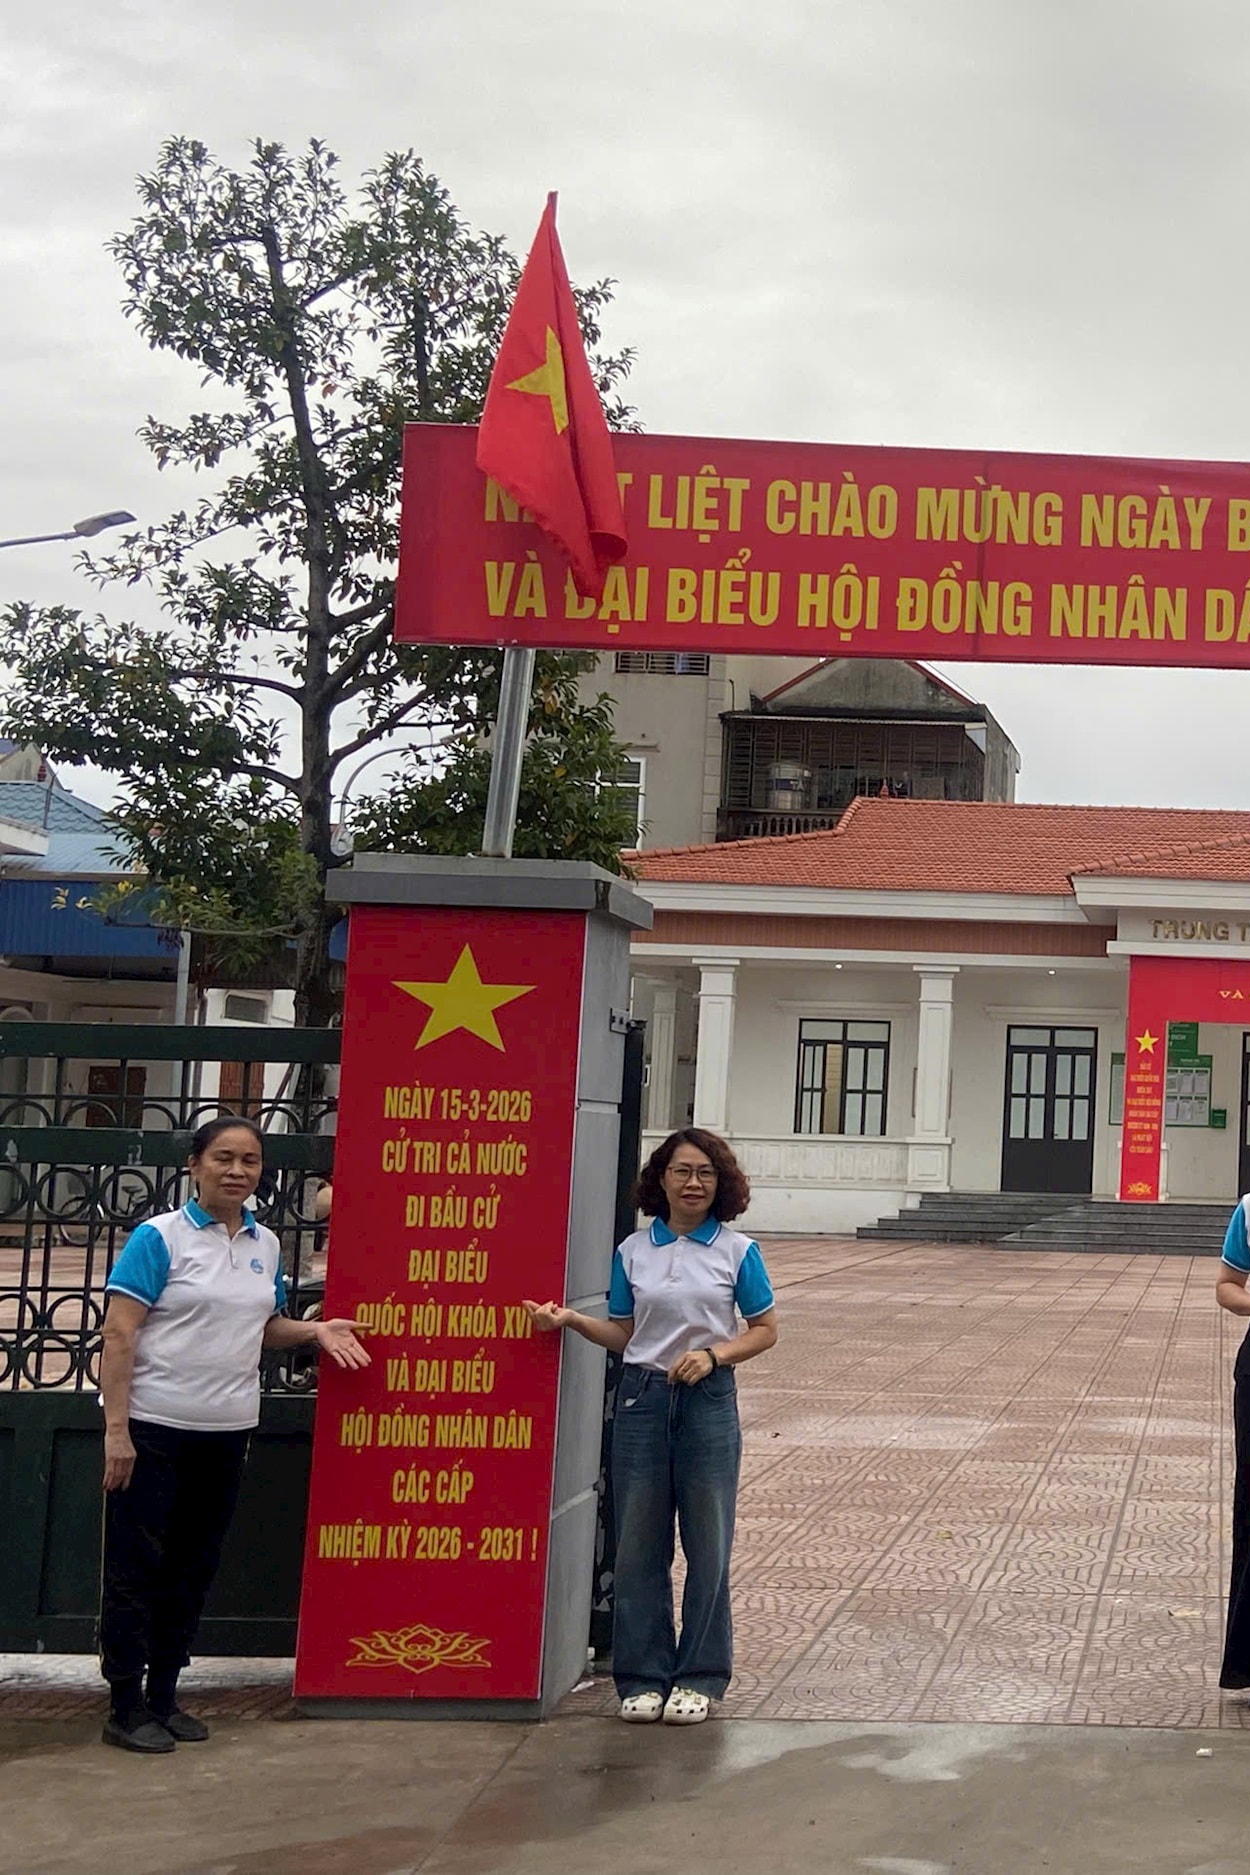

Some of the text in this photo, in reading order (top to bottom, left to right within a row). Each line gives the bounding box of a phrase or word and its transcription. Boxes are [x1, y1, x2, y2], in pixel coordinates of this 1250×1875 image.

[648, 464, 750, 543] LIỆT
[766, 472, 898, 539] CHÀO
[916, 476, 1063, 545] MỪNG
[1081, 485, 1212, 550] NGÀY
[484, 551, 547, 617] VÀ
[666, 548, 781, 626] BIỂU
[797, 563, 880, 641] HỘI
[896, 561, 1032, 636] ĐỒNG
[1050, 575, 1187, 640] NHÂN
[1150, 918, 1229, 942] TRUNG
[384, 1080, 531, 1122] NGÀY 15-3-2026
[382, 1127, 527, 1176] CỬ TRI CẢ NƯỚC
[405, 1183, 501, 1229] ĐI BẦU CỬ
[408, 1238, 488, 1290] ĐẠI BIỂU
[355, 1290, 407, 1339] QUỐC
[411, 1297, 444, 1345] HỘI
[447, 1298, 497, 1339] KHÓA
[387, 1347, 495, 1400] VÀ ĐẠI BIỂU
[340, 1403, 532, 1454] HỘI ĐỒNG NHÂN DÂN
[392, 1459, 474, 1504] CÁC CẤP
[318, 1518, 382, 1566] NHIỆM
[386, 1519, 412, 1559] KỲ
[414, 1526, 461, 1560] 2026
[479, 1527, 523, 1561] 2031
